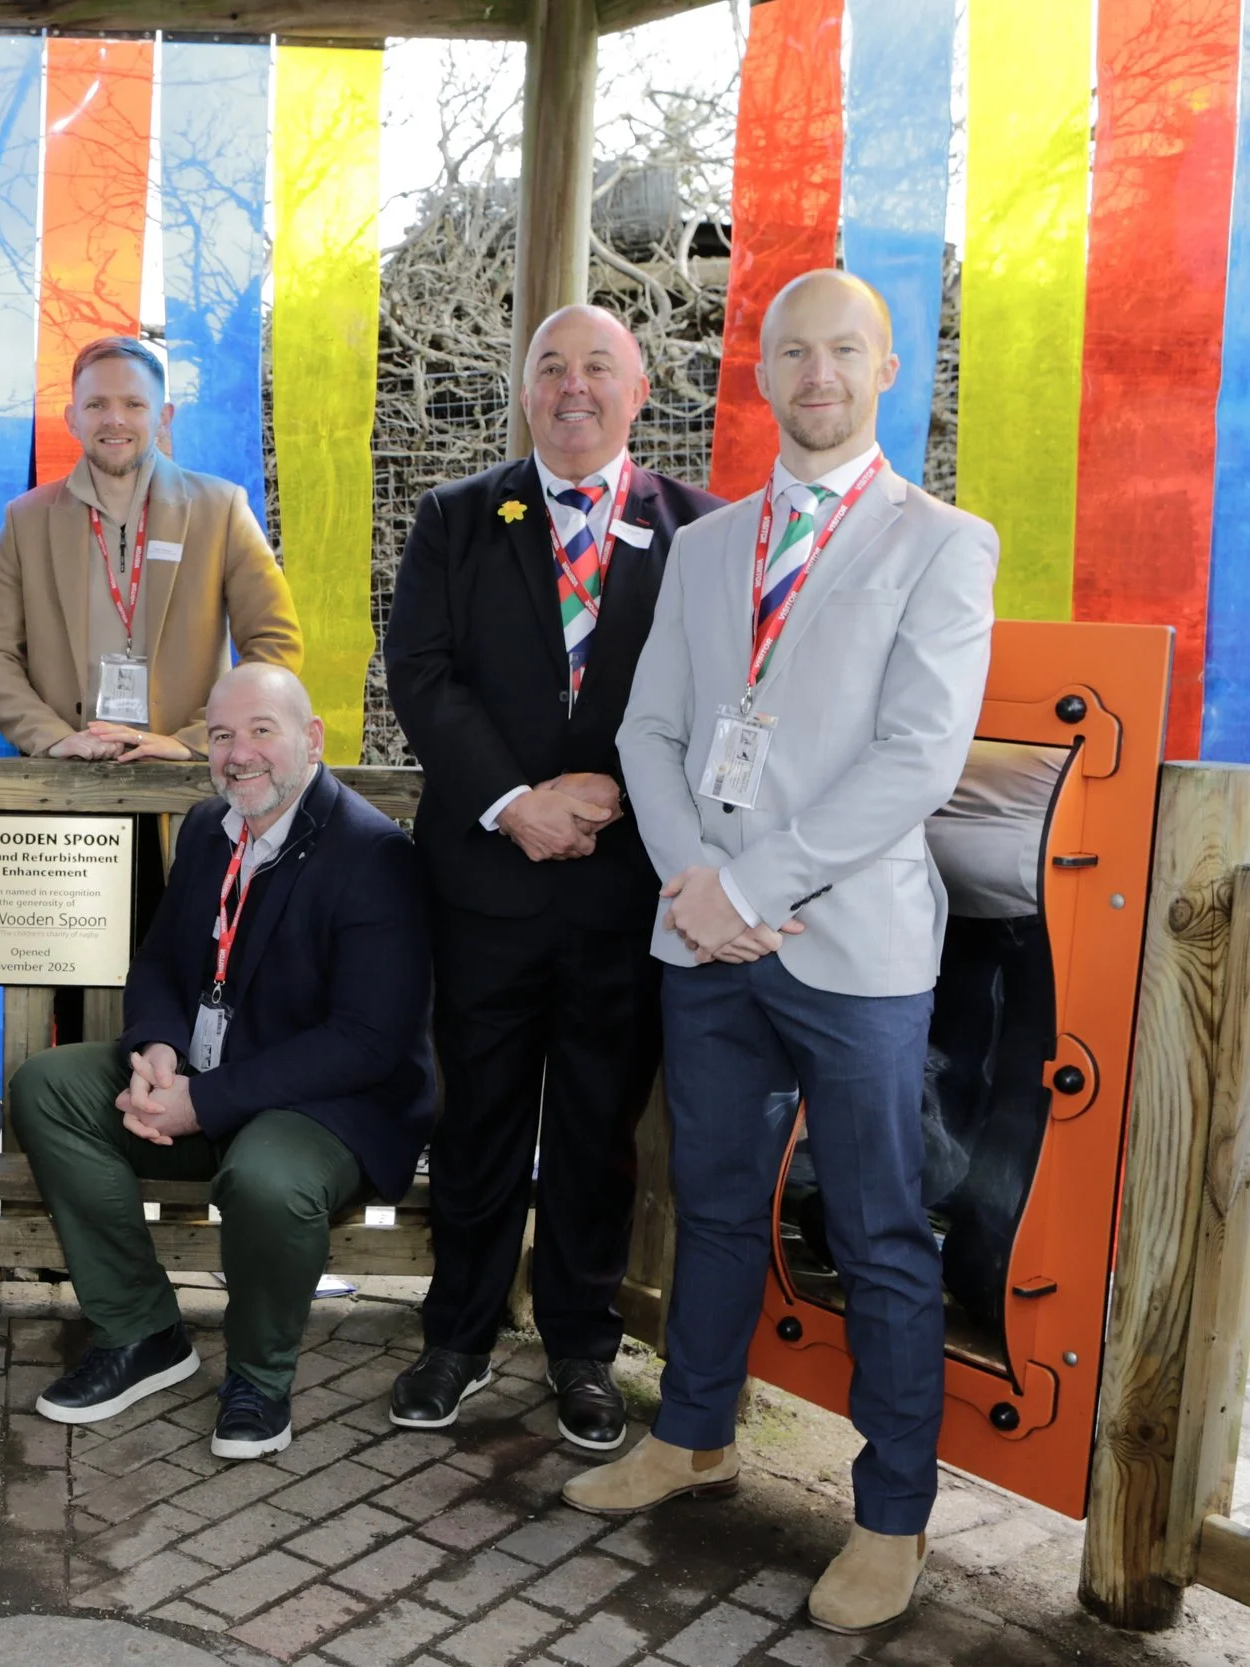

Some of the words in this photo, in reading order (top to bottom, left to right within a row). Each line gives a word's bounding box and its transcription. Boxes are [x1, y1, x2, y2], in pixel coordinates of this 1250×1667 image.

[855, 468, 875, 491] VISITOR
[760, 516, 771, 544] VISITOR
[827, 505, 848, 532] VISITOR
[804, 547, 823, 575] VISITOR
[562, 561, 578, 587] VISITOR
[755, 558, 764, 588] VISITOR
[778, 590, 799, 620] VISITOR
[755, 638, 774, 668] VISITOR
[63, 833, 120, 846] SPOON
[22, 852, 118, 864] Refurbishment
[2, 867, 88, 878] Enhancement
[5, 888, 36, 896] named
[39, 888, 47, 896] in
[49, 888, 101, 898] recognition
[221, 874, 232, 898] VISITOR
[16, 899, 63, 909] generosity
[66, 899, 76, 907] of
[59, 912, 107, 929] Spoon
[46, 930, 69, 939] charity
[10, 948, 50, 958] Opened
[218, 948, 226, 973] VISITOR
[48, 962, 76, 972] 2025
